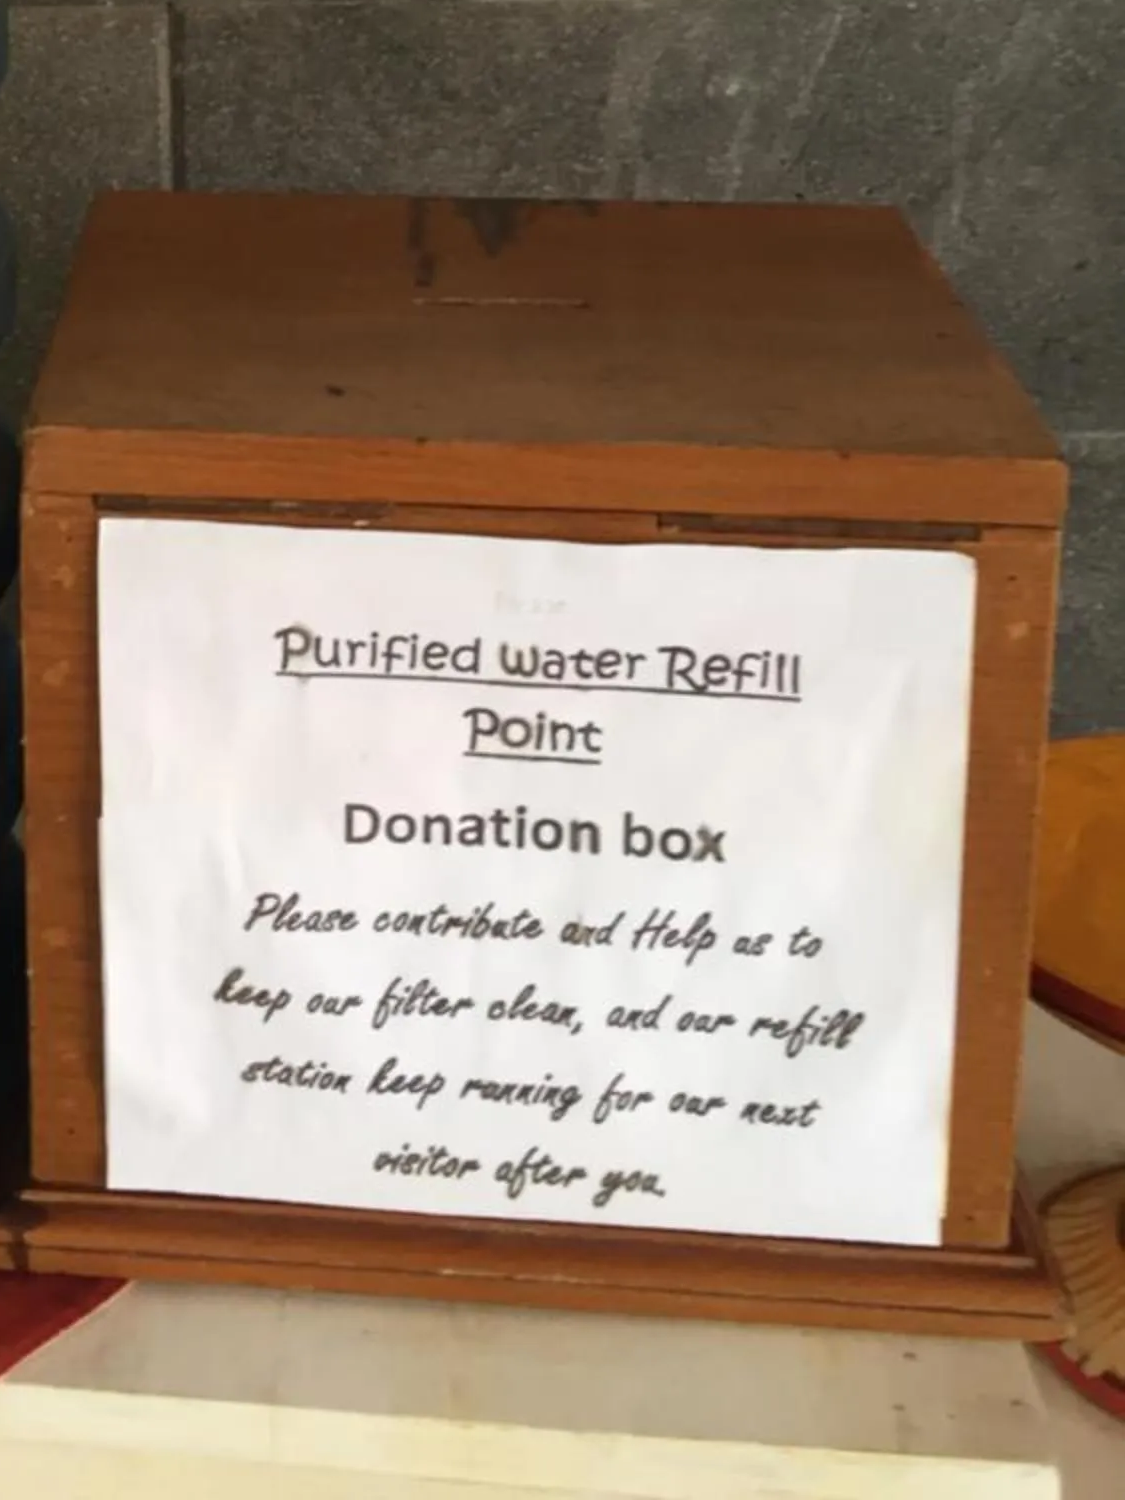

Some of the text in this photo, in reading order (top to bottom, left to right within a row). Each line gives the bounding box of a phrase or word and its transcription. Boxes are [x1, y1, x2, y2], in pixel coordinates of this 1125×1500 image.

[273, 622, 483, 678] Purified
[657, 644, 803, 697] Refill
[462, 706, 604, 755] Point
[343, 802, 728, 864] Donation box
[242, 891, 360, 933] Please
[371, 901, 546, 941] contribute
[558, 908, 627, 948] and
[629, 907, 719, 968] Help
[787, 925, 824, 959] to
[212, 965, 867, 1060] keep our filter clean, and our refill
[239, 1055, 823, 1129] station keep running for our next
[372, 1142, 482, 1180] visitor
[493, 1145, 589, 1200] after
